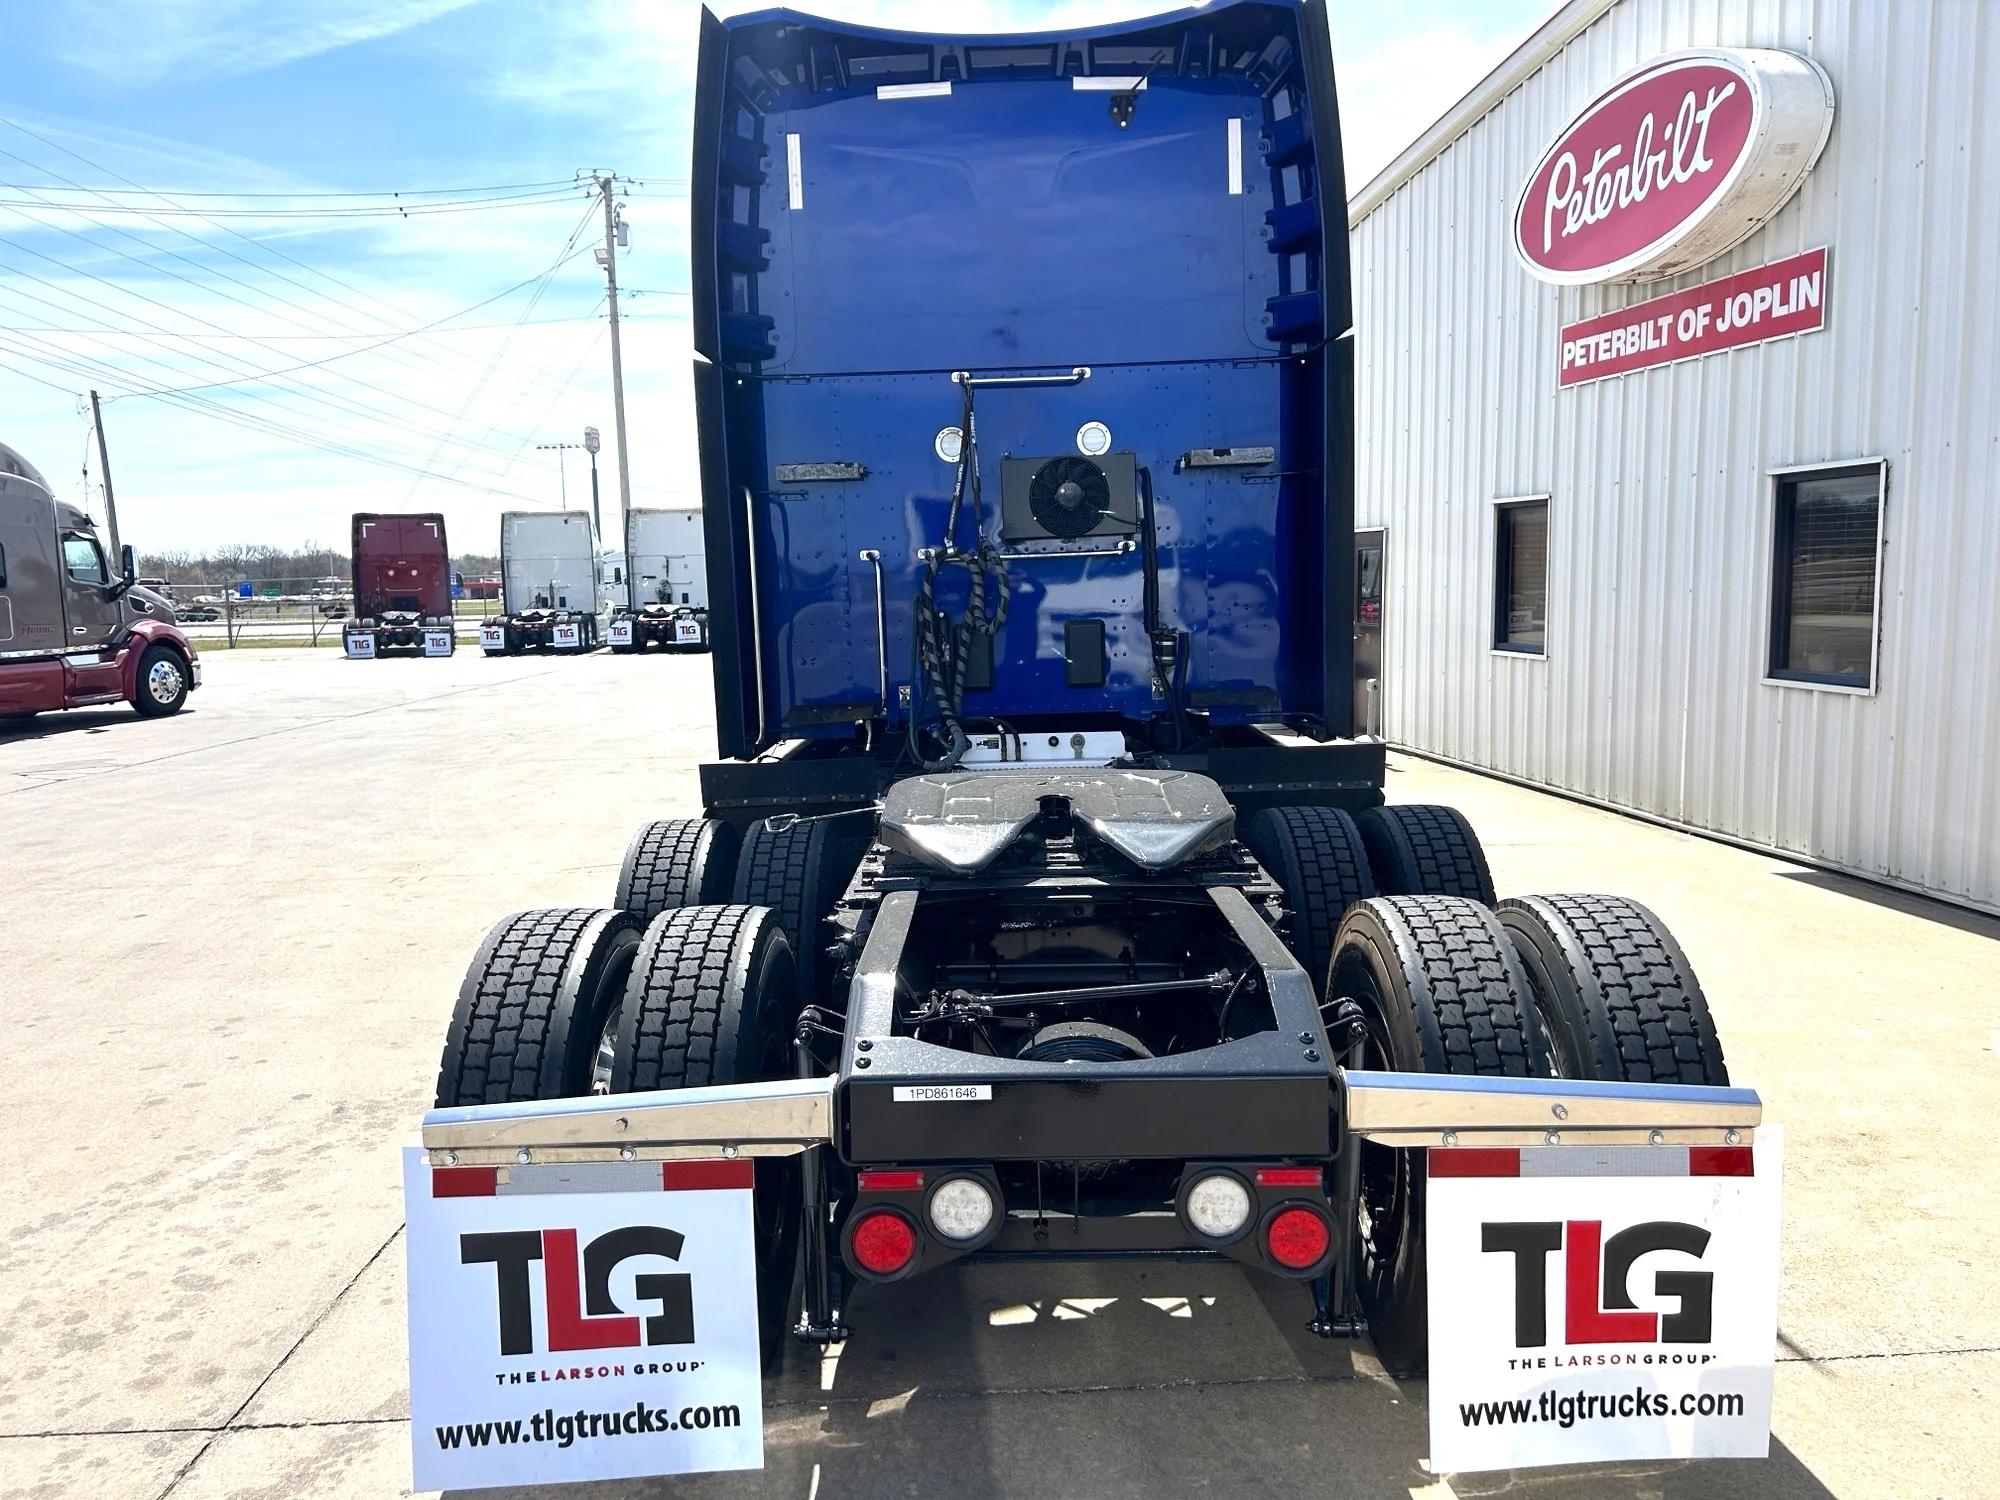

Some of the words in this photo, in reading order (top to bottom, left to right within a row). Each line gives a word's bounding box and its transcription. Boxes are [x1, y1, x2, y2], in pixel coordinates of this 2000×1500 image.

[1543, 81, 1736, 254] Peterbilt
[1562, 314, 1673, 370] PETERBILT
[1677, 305, 1712, 342] OF
[1716, 270, 1821, 333] JOPLIN
[484, 630, 500, 640] TLG
[557, 628, 574, 638] TLG
[611, 626, 628, 636] TLG
[679, 625, 696, 635] TLG
[352, 639, 370, 649] TLG
[429, 637, 446, 647] TLG
[910, 1087, 977, 1099] 1PD861646
[460, 1225, 695, 1356] TLG
[1481, 1219, 1714, 1348] TLG
[1508, 1357, 1547, 1370] THE
[1554, 1354, 1637, 1367] LARSON
[1643, 1354, 1711, 1365] GROUP
[496, 1371, 537, 1385] THE
[541, 1365, 625, 1382] LARSON
[633, 1361, 699, 1376] GROUP
[1459, 1386, 1744, 1428] www.tlgtrucks.com
[436, 1402, 741, 1450] www.tlgtrucks.com
